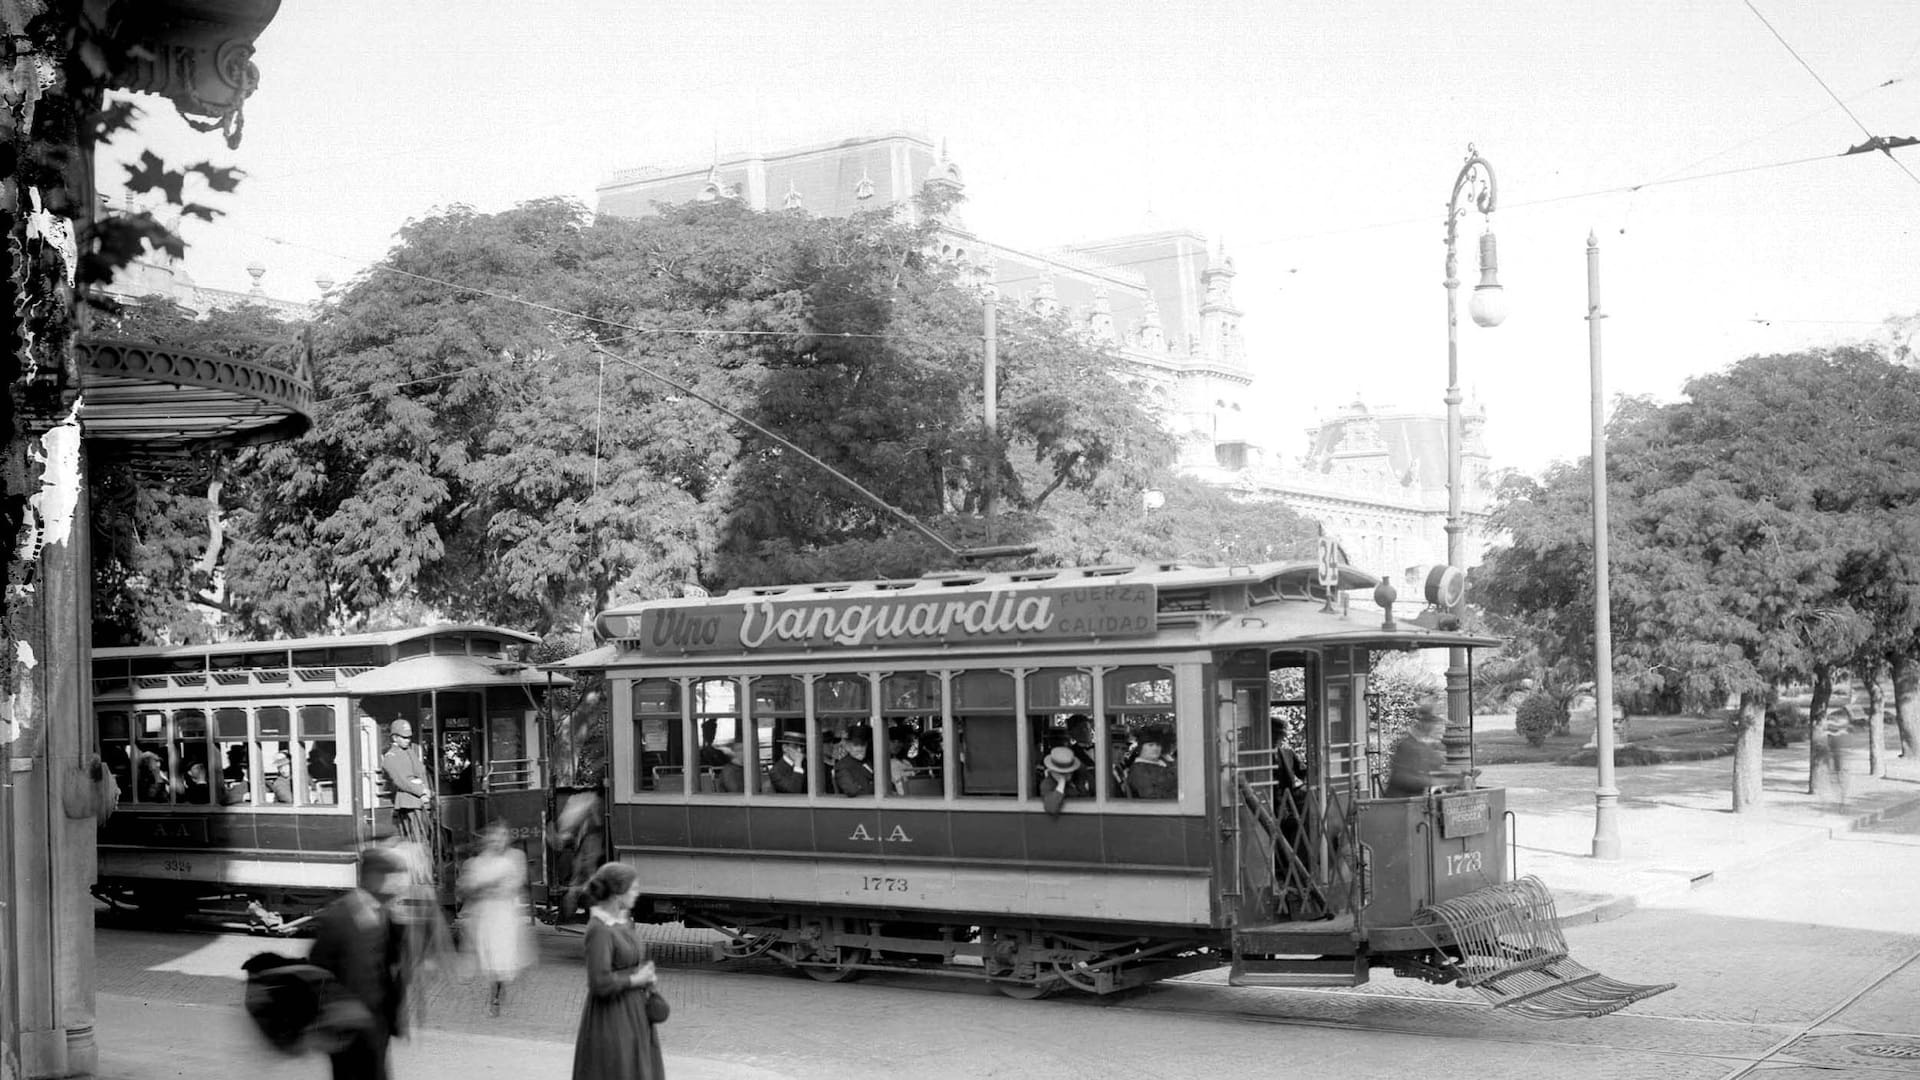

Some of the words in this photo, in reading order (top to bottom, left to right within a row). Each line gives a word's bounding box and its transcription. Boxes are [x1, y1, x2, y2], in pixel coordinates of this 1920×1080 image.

[1060, 587, 1147, 607] FUERZA
[652, 608, 721, 647] Vino
[739, 590, 1055, 648] Vanguardia
[1058, 616, 1149, 633] CALIDAD
[1446, 851, 1482, 876] 1773
[862, 875, 909, 893] 1773
